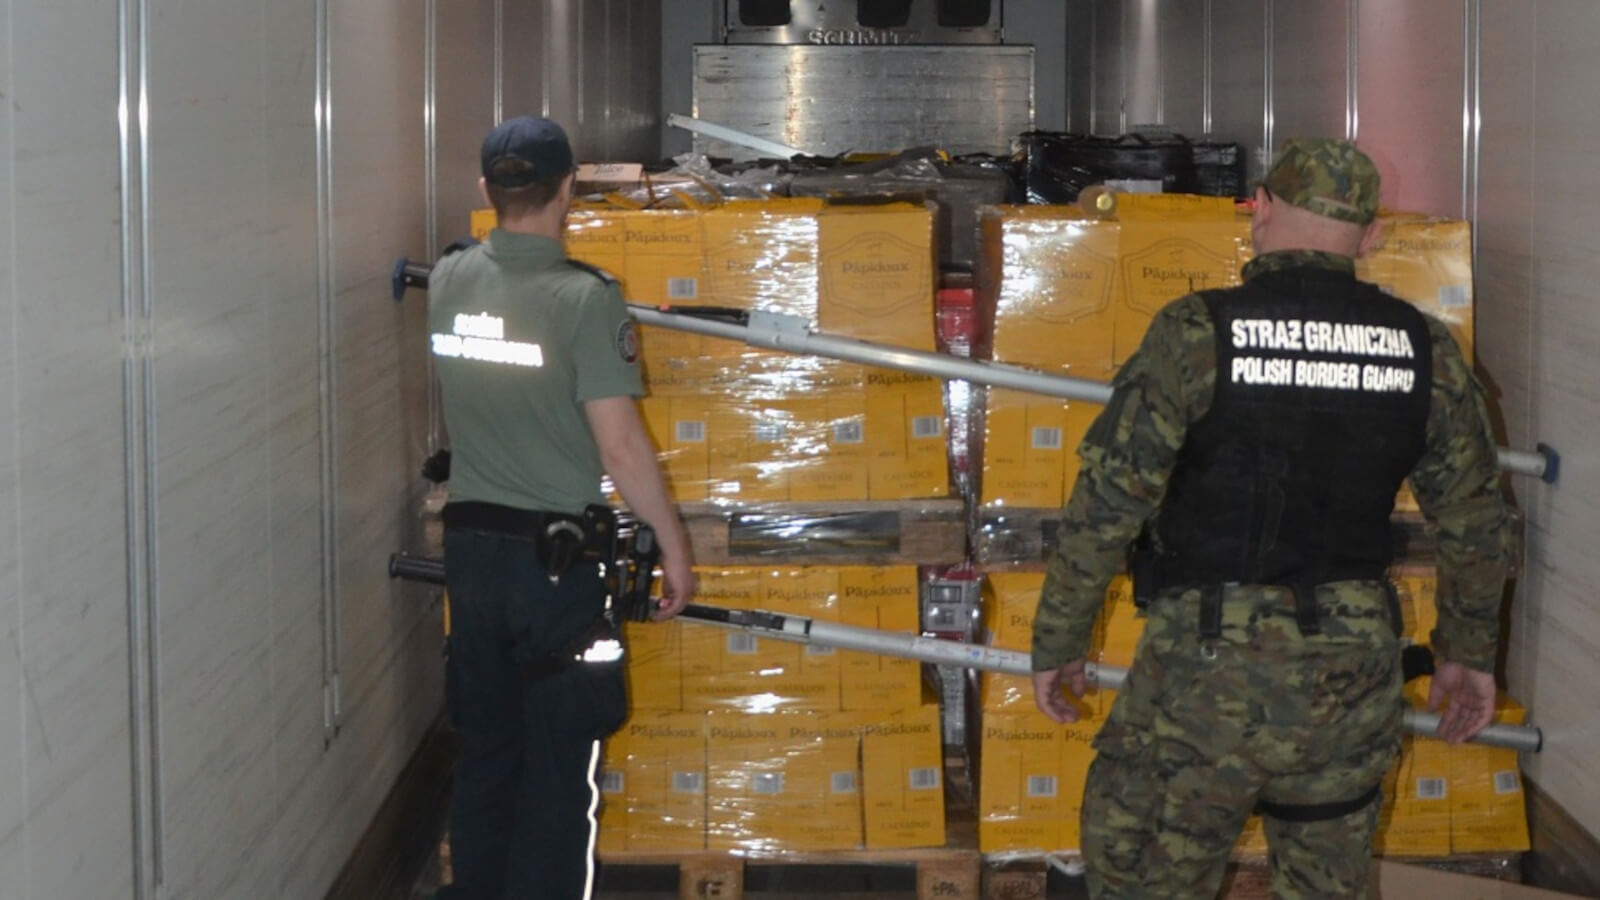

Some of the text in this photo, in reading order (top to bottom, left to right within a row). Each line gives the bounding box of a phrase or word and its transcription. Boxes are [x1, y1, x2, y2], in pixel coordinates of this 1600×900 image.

[1304, 320, 1415, 359] GRANICZNA
[1231, 357, 1415, 393] POLISH BORDER GUARD
